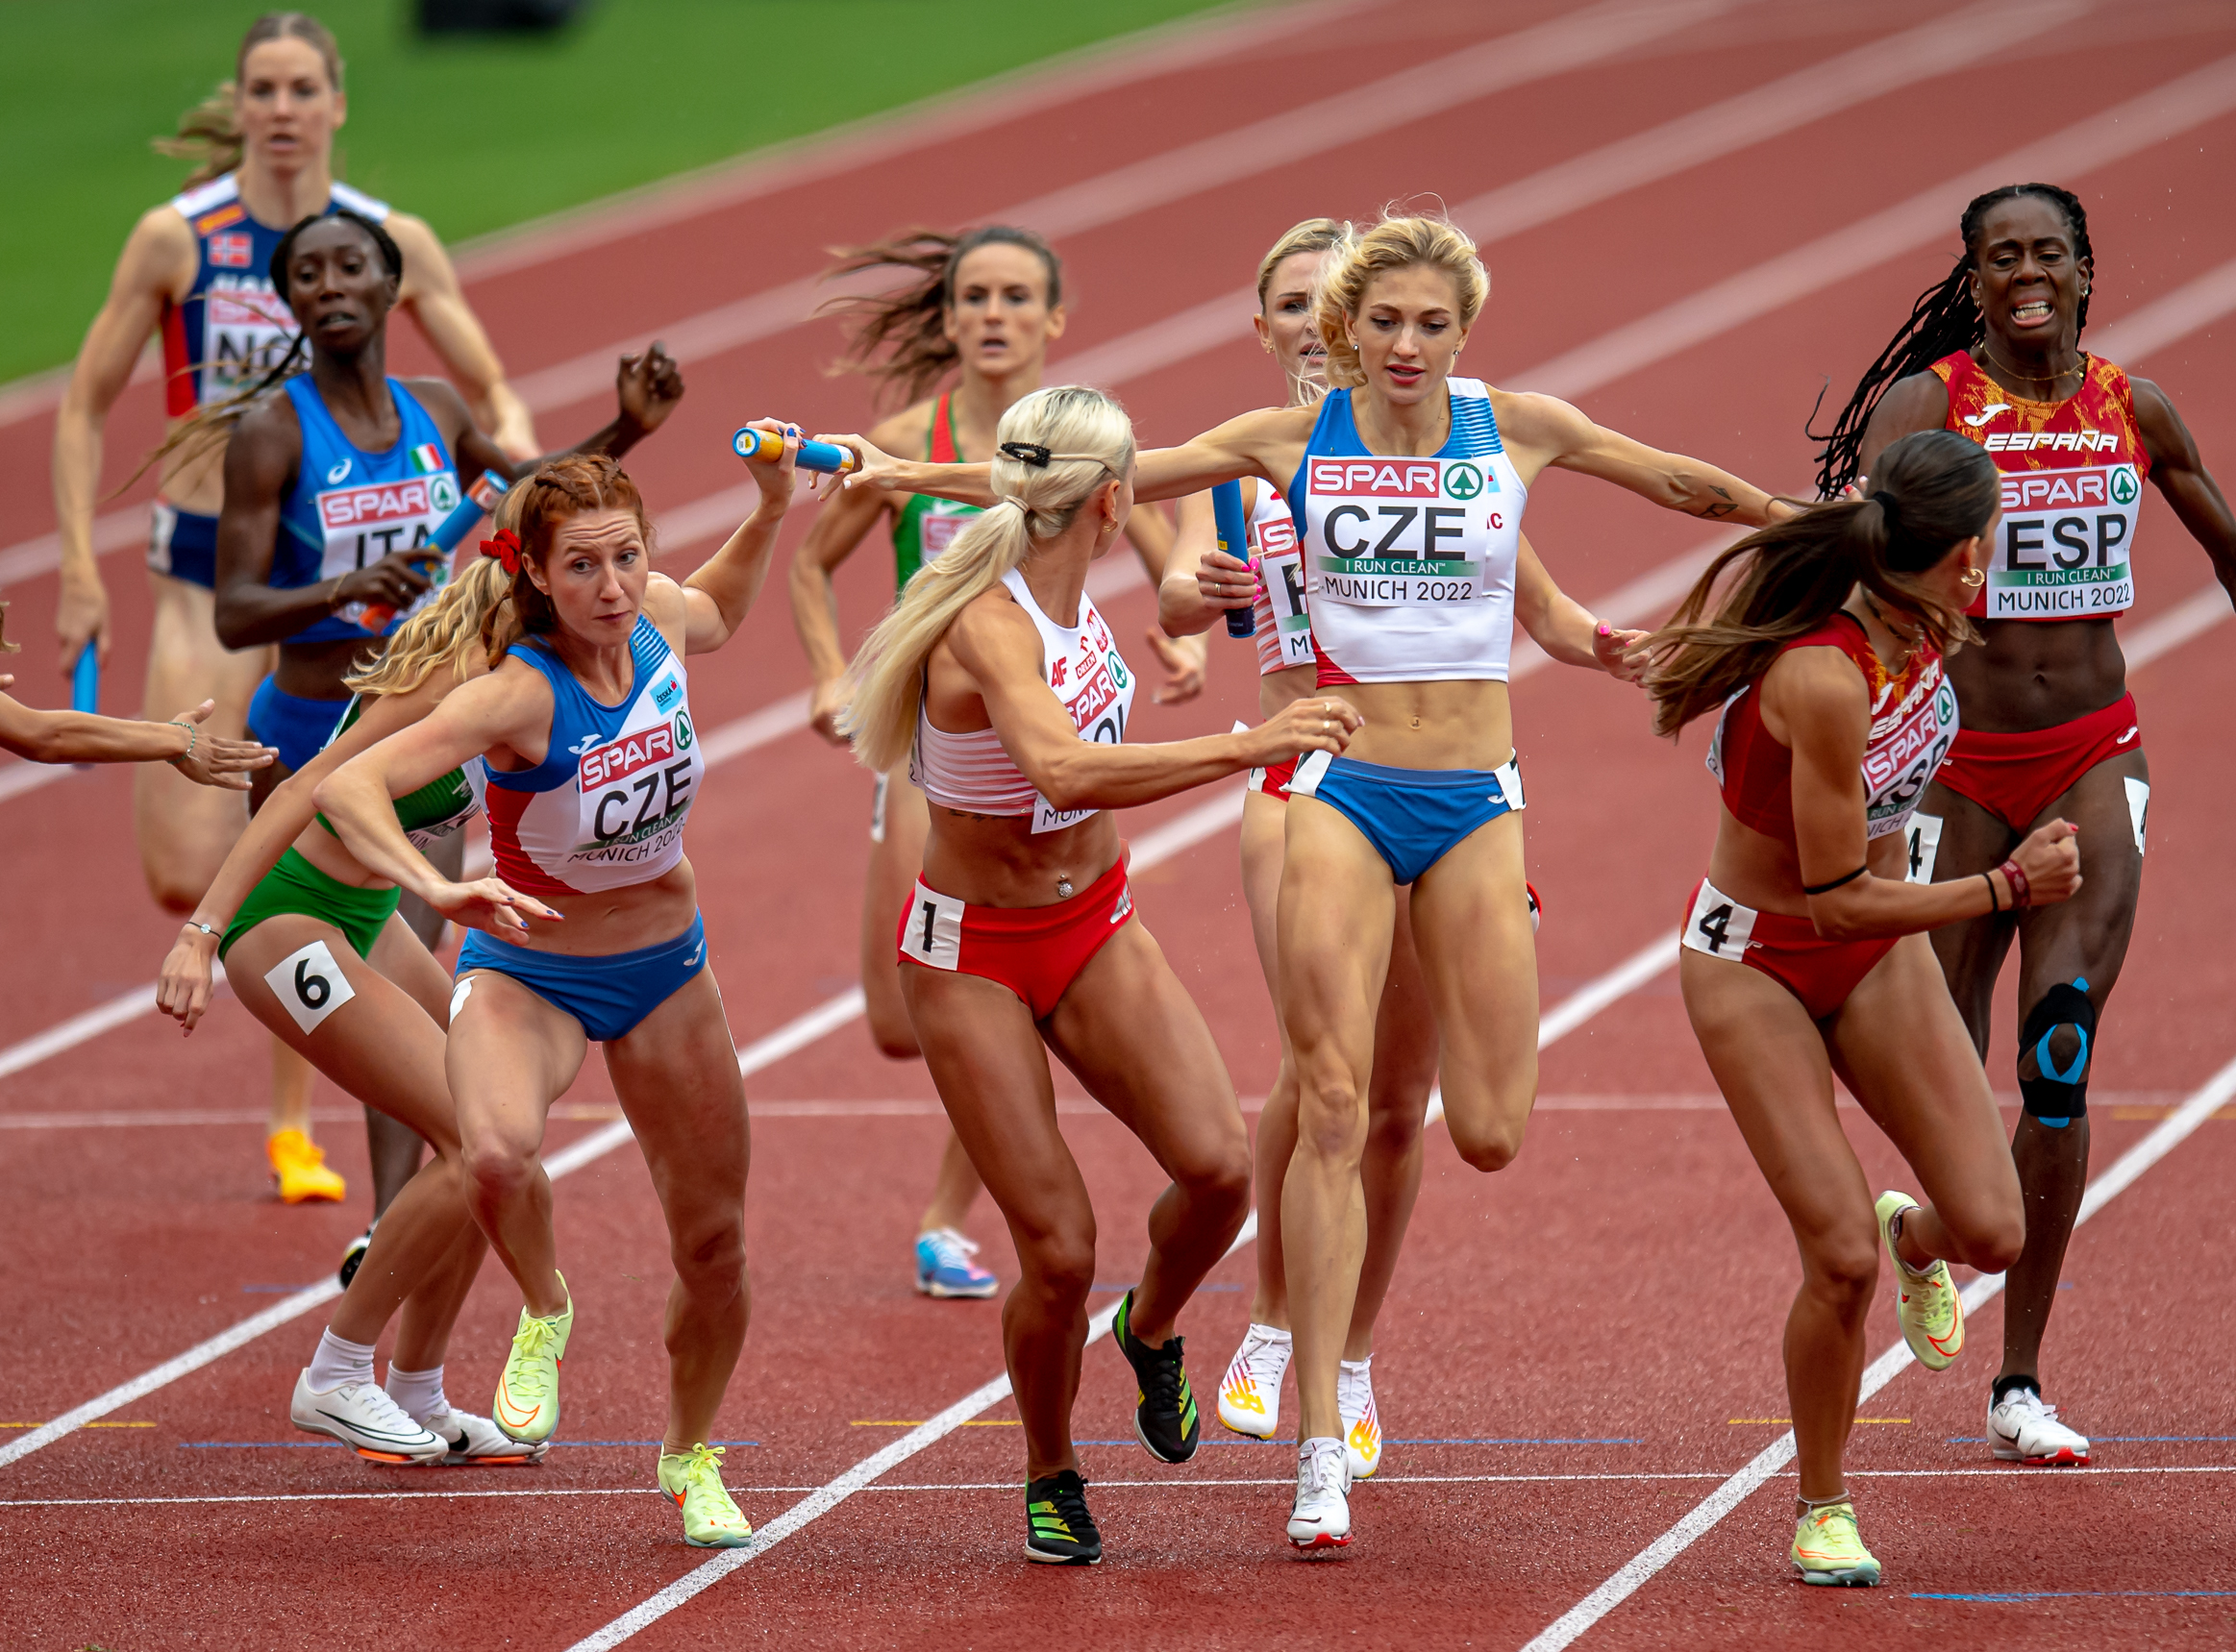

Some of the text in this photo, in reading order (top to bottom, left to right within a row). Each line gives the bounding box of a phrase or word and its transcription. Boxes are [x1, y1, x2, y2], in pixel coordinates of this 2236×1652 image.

[1984, 430, 2119, 453] ESPAÑA
[1313, 463, 1436, 493] SPAR
[2000, 475, 2105, 508] SPAR
[325, 485, 427, 524] SPAR
[1324, 505, 1466, 561] CZE
[2006, 513, 2127, 571] ESP
[1354, 560, 1386, 573] RUN
[2035, 572, 2066, 584] RUN
[1325, 576, 1407, 601] MUNICH
[1416, 581, 1473, 602] 2022
[1998, 582, 2130, 611] MUNICH 2022
[1078, 653, 1096, 677] ORLEN
[583, 729, 671, 786] SPAR
[1867, 709, 1936, 784] SPAR
[594, 756, 692, 841] CZE
[567, 842, 650, 862] MUNICH
[922, 900, 937, 952] 1
[1699, 903, 1733, 953] 4
[294, 957, 332, 1010] 6
